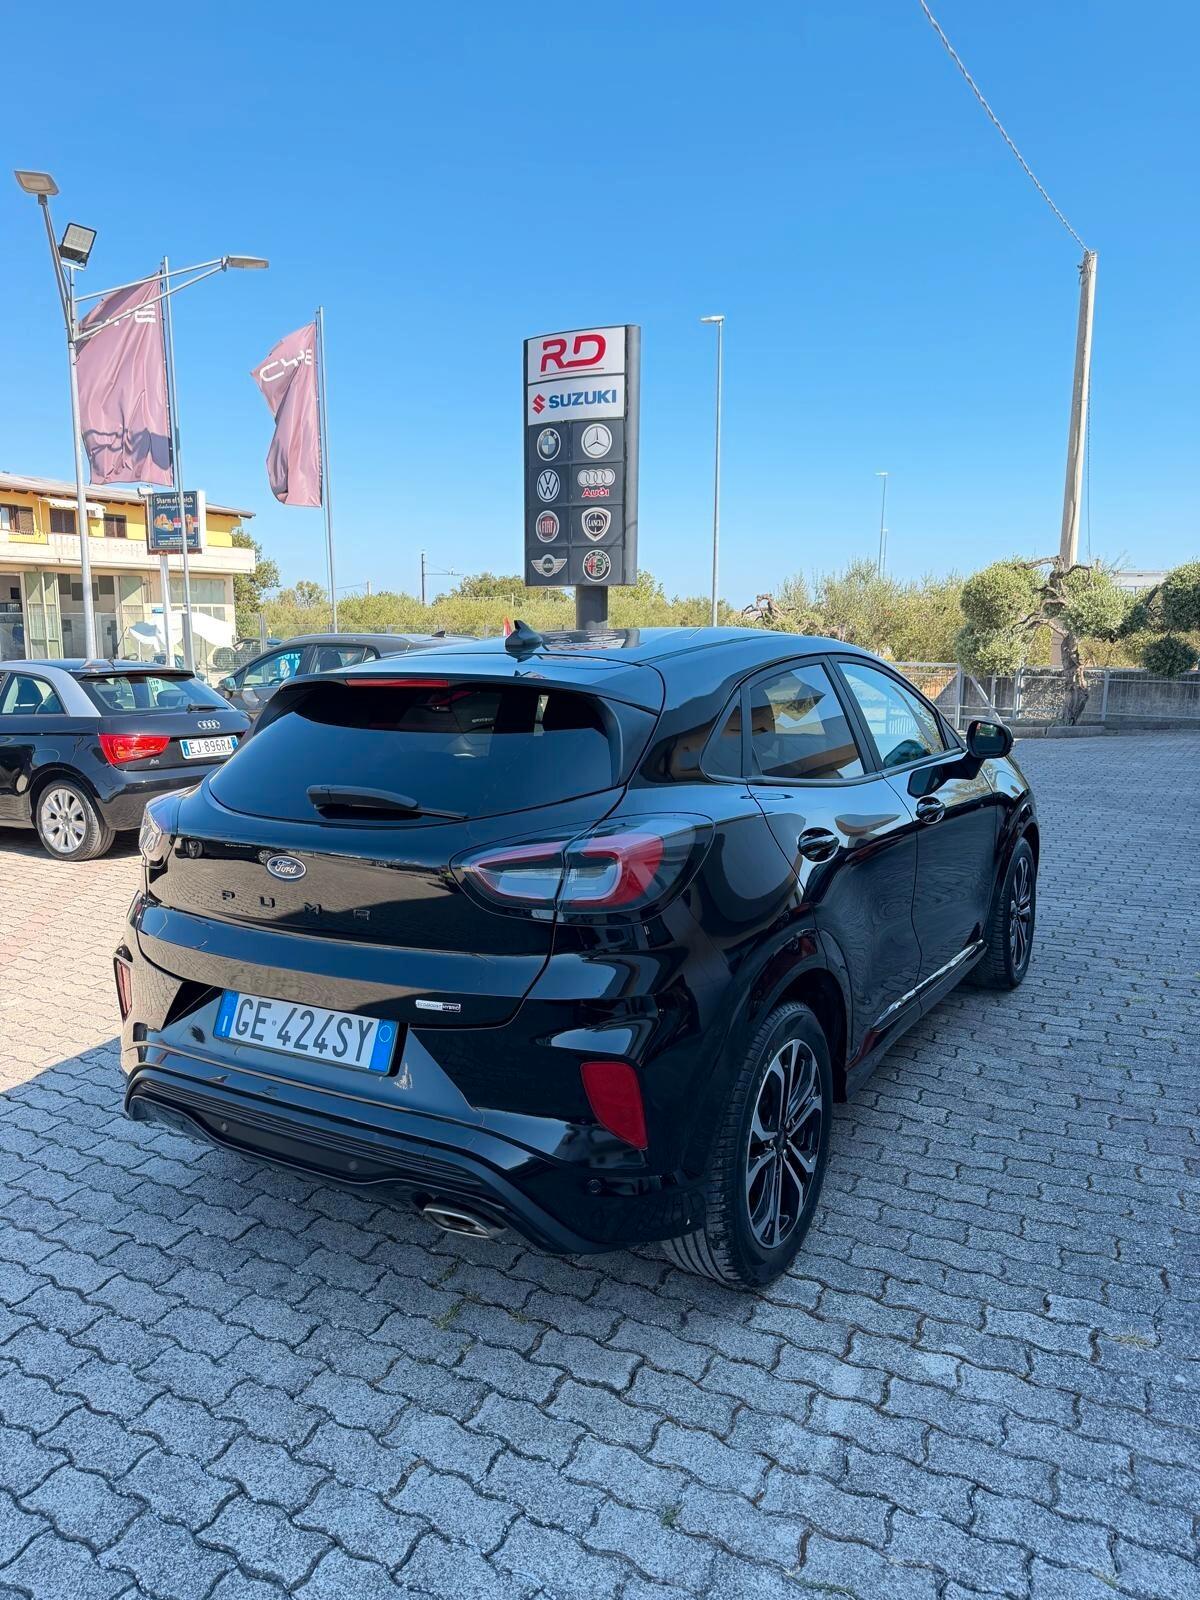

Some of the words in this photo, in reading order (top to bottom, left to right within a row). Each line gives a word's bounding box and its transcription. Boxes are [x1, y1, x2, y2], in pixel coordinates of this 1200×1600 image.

[540, 333, 606, 372] RD
[548, 389, 617, 408] SUZUKI
[581, 488, 609, 497] Audi
[541, 520, 554, 533] FIAT
[190, 741, 201, 753] EJ
[204, 738, 233, 752] 896RA
[275, 859, 297, 874] Ford
[235, 998, 272, 1042] GE
[276, 1007, 374, 1062] 424SY
